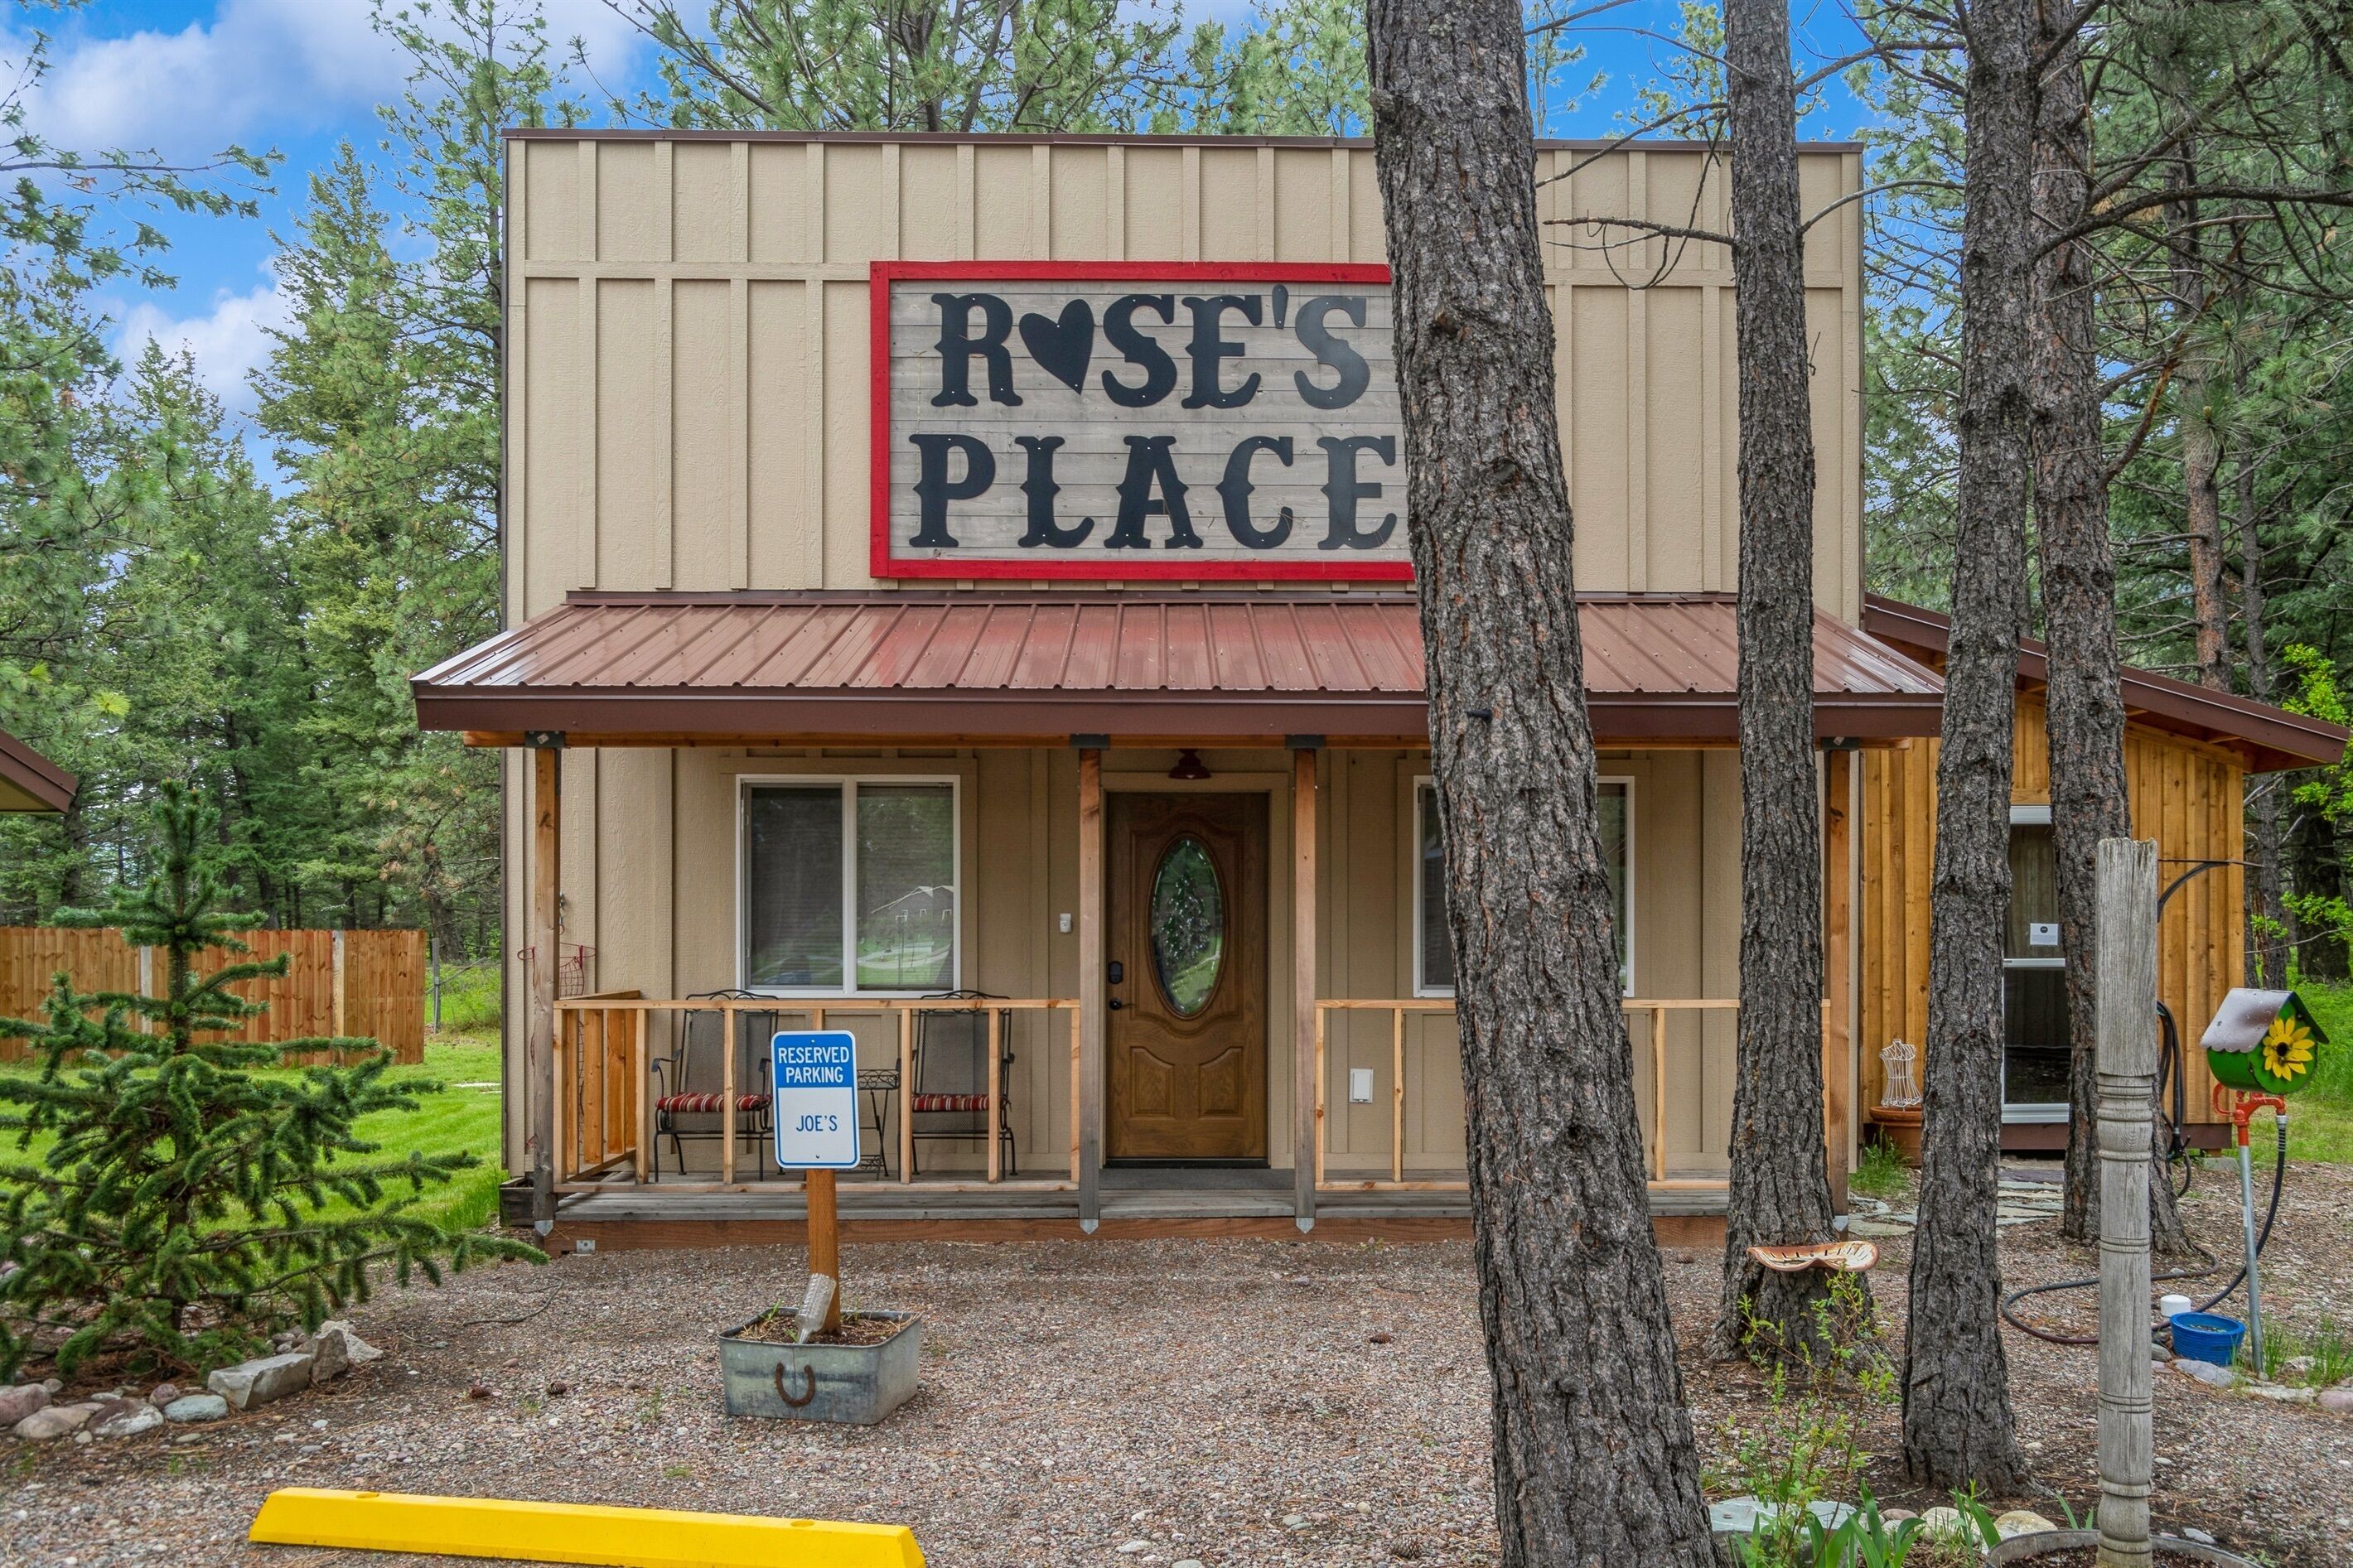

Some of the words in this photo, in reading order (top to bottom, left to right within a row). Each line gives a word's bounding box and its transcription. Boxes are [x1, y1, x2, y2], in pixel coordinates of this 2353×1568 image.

[909, 433, 1398, 550] PLACE
[778, 1046, 849, 1064] RESERVED
[785, 1066, 843, 1083] PARKING
[796, 1114, 838, 1131] JOE'S
